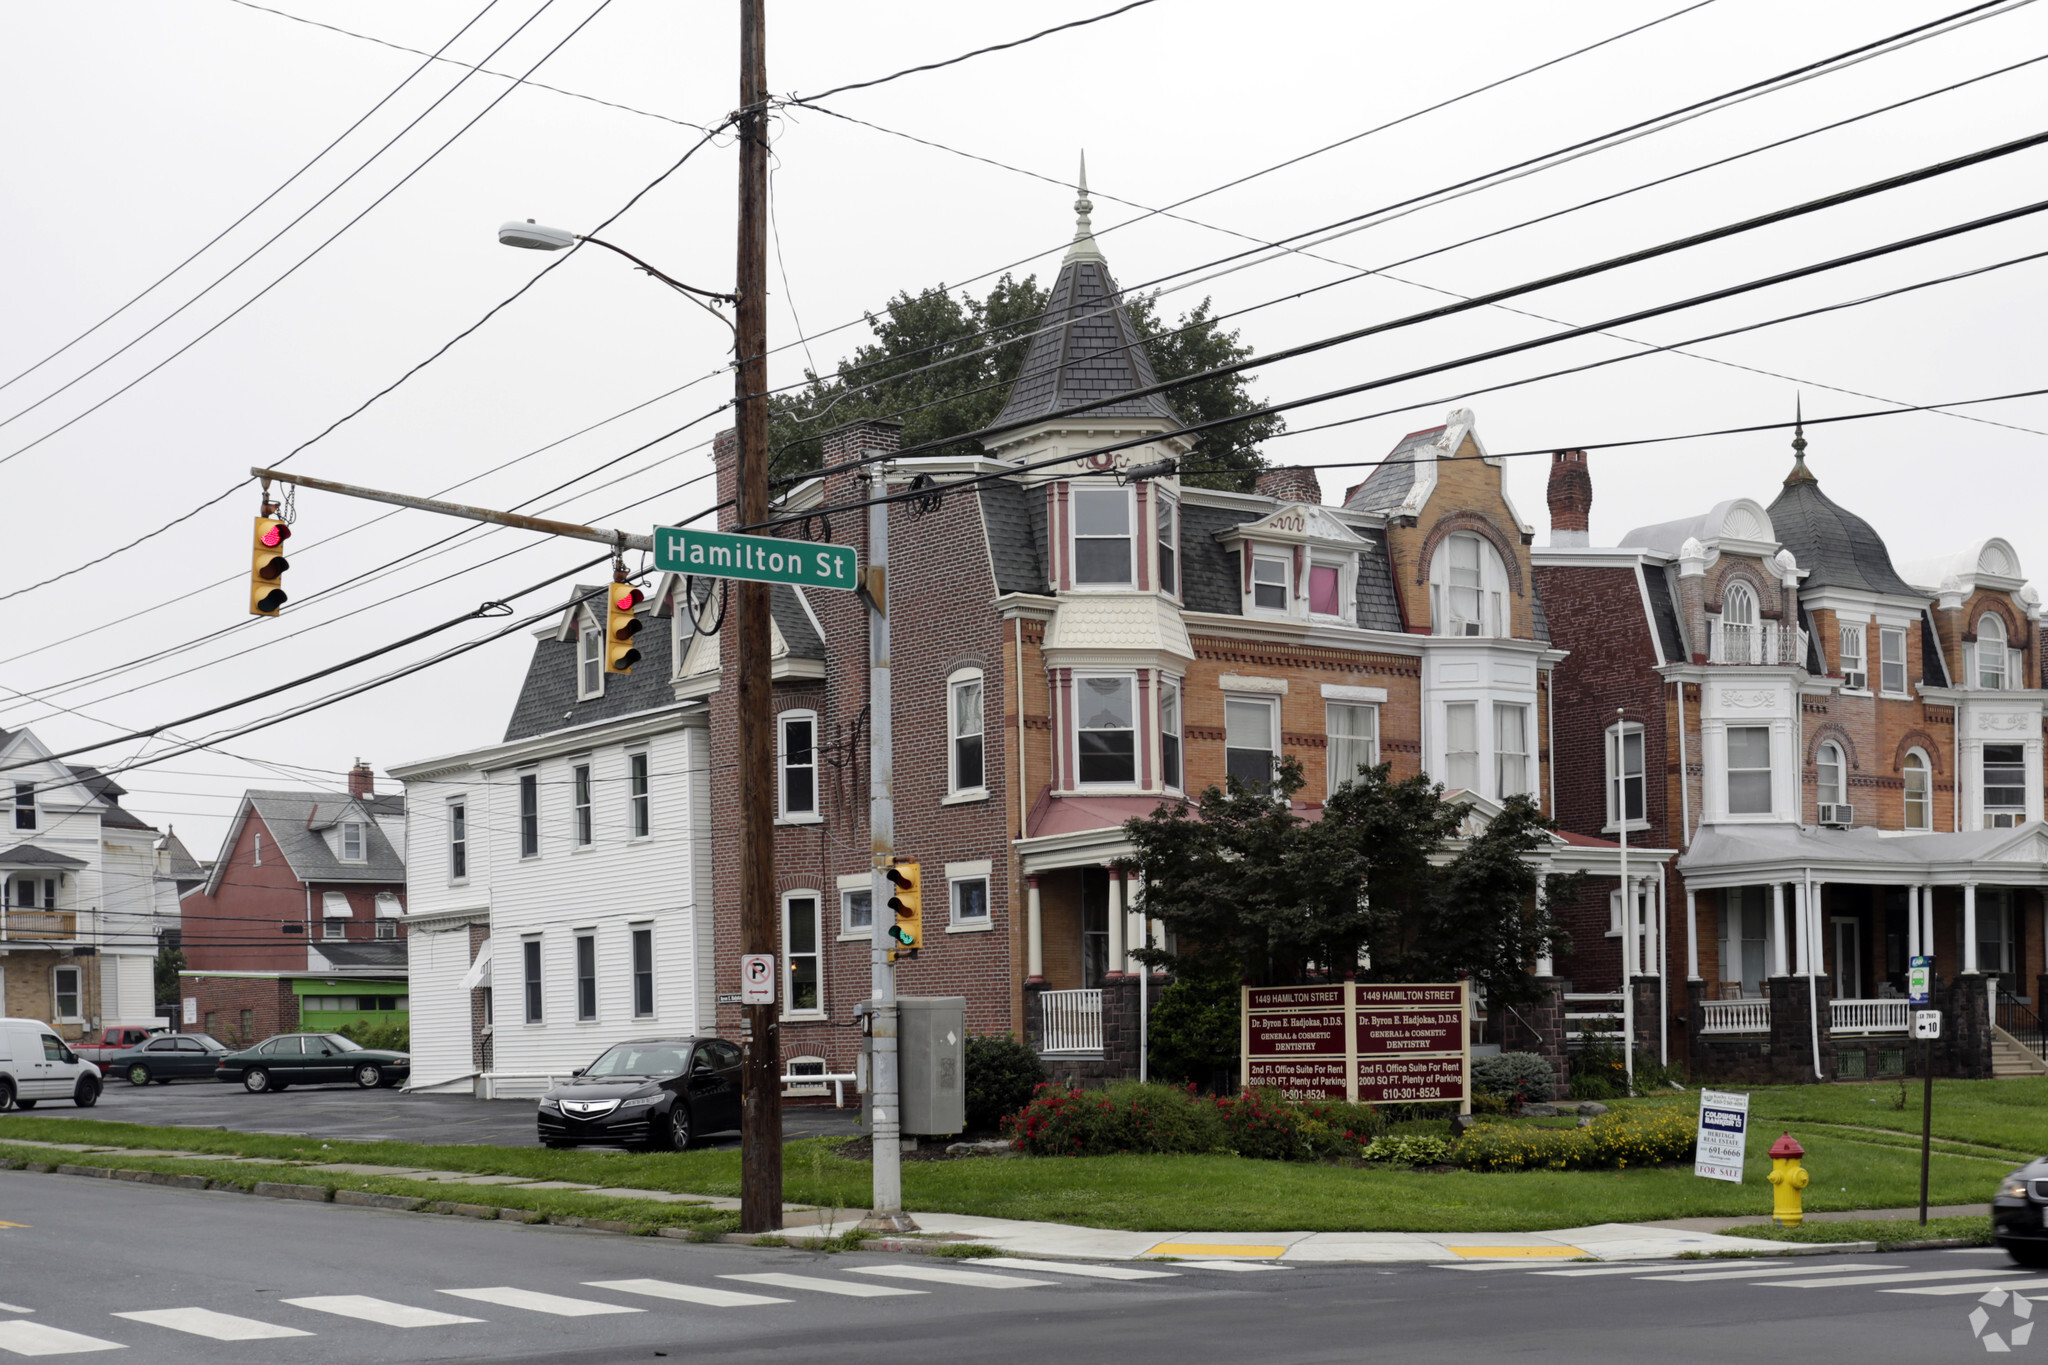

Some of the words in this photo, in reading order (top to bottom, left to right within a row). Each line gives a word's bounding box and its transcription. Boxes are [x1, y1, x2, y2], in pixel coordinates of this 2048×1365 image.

[668, 536, 802, 574] Hamilton
[816, 552, 844, 578] St
[1255, 994, 1271, 1004] 1449
[1272, 993, 1309, 1003] HAMILTON
[1311, 992, 1338, 1001] STREET
[1363, 992, 1380, 1000] 1449
[1382, 991, 1423, 1000] HAMILTON
[1425, 991, 1455, 1000] STREET
[1252, 1019, 1261, 1028] Dr.
[1262, 1019, 1281, 1029] Byron
[1291, 1018, 1322, 1028] Hadjokas,
[1323, 1017, 1342, 1026] D.D.S.
[1359, 1017, 1370, 1025] Dr.
[1372, 1016, 1392, 1027] Byron
[1394, 1016, 1401, 1024] E.
[1403, 1015, 1437, 1026] Hadjokas,
[1438, 1015, 1459, 1023] D.D.S.
[1929, 1022, 1937, 1032] 10
[1386, 1040, 1430, 1048] DENTISTRY
[1252, 1066, 1264, 1074] 2nd
[1275, 1066, 1294, 1074] Office
[1296, 1065, 1313, 1073] Suite
[1315, 1065, 1326, 1073] For
[1328, 1065, 1343, 1073] Rent
[1361, 1065, 1374, 1073] 2nd
[1386, 1064, 1407, 1072] Office
[1409, 1063, 1427, 1072] Suite
[1429, 1063, 1440, 1071] For
[1443, 1062, 1459, 1071] Rent
[1250, 1077, 1265, 1085] 2000
[1290, 1077, 1310, 1087] Plenty
[1312, 1077, 1319, 1085] of
[1321, 1077, 1346, 1087] Parking
[1359, 1077, 1375, 1085] 2000
[1377, 1076, 1387, 1085] SQ
[1389, 1076, 1400, 1084] FT.
[1402, 1075, 1424, 1085] Plenty
[1426, 1075, 1433, 1083] of
[1435, 1074, 1462, 1084] Parking
[1383, 1087, 1440, 1099] 610-301-8524
[1708, 1131, 1736, 1139] HERITAGE
[1708, 1146, 1740, 1157] 691-6666
[1699, 1166, 1715, 1174] FOR
[1720, 1169, 1738, 1177] SALE
